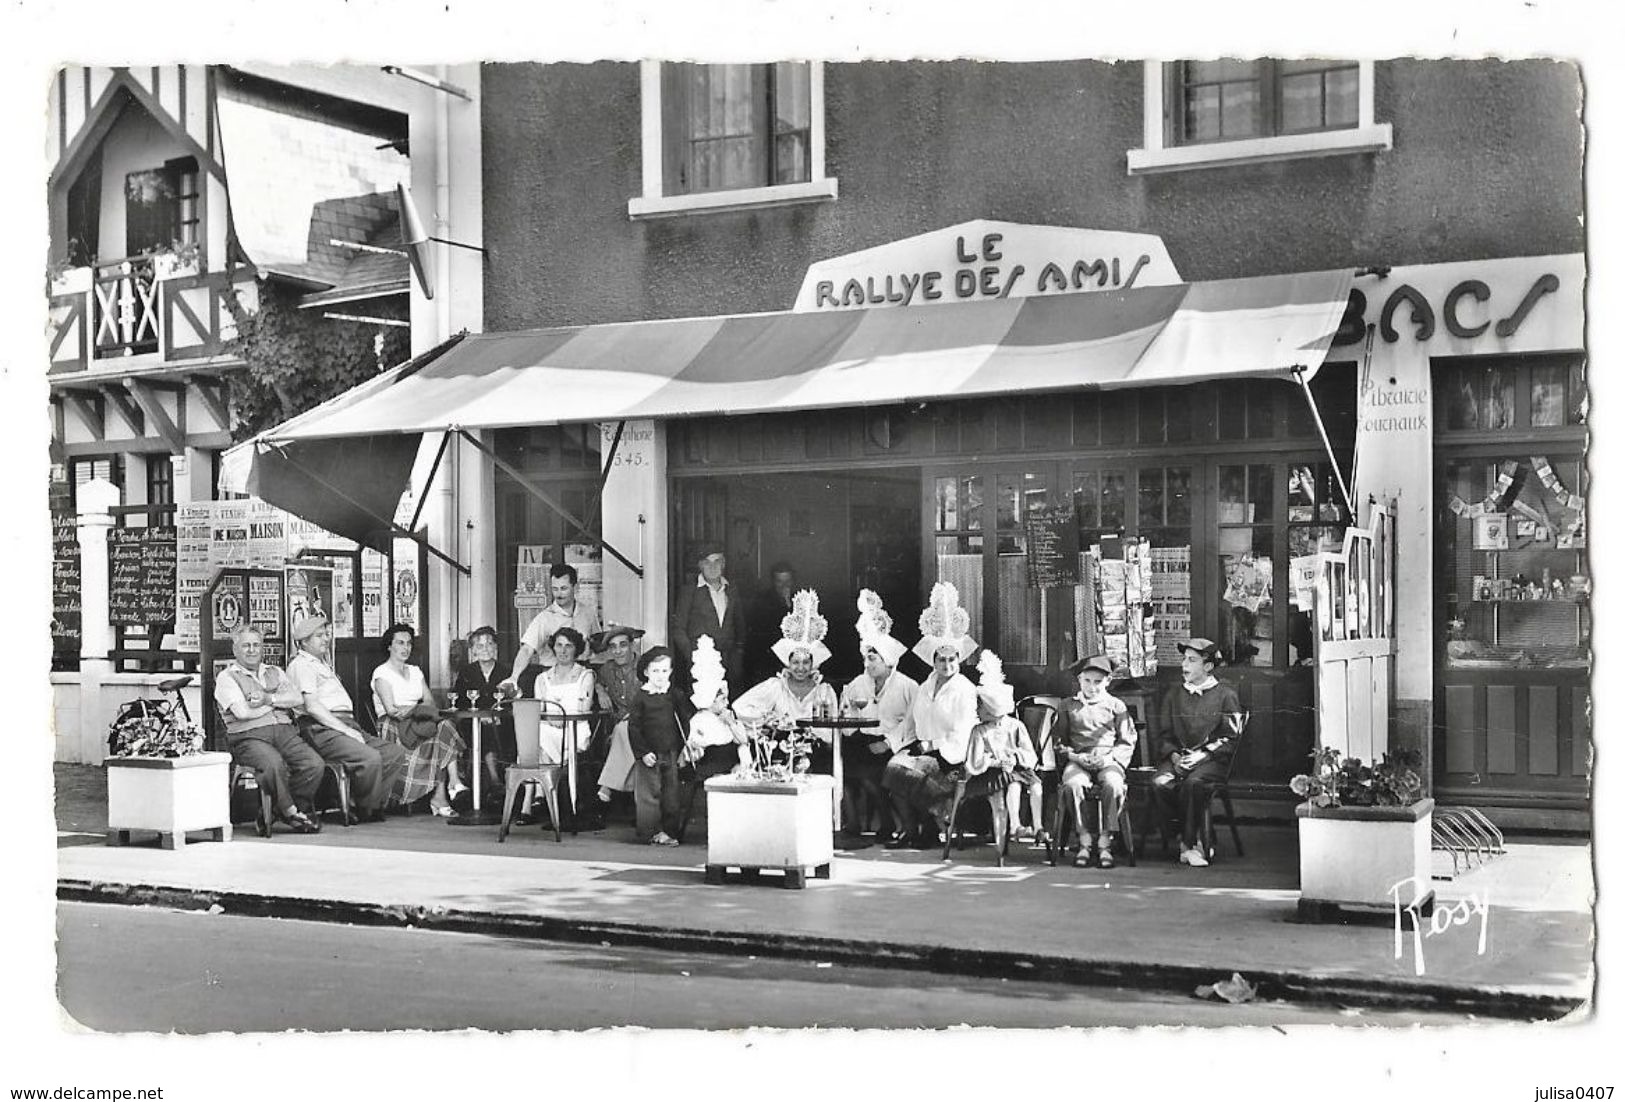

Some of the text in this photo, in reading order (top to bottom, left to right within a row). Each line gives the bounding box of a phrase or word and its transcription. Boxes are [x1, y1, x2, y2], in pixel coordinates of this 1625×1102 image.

[956, 233, 1004, 263] LE
[816, 255, 1151, 307] RALLYE DES AMIS
[1359, 415, 1427, 432] ournaux
[250, 522, 284, 539] MAISON
